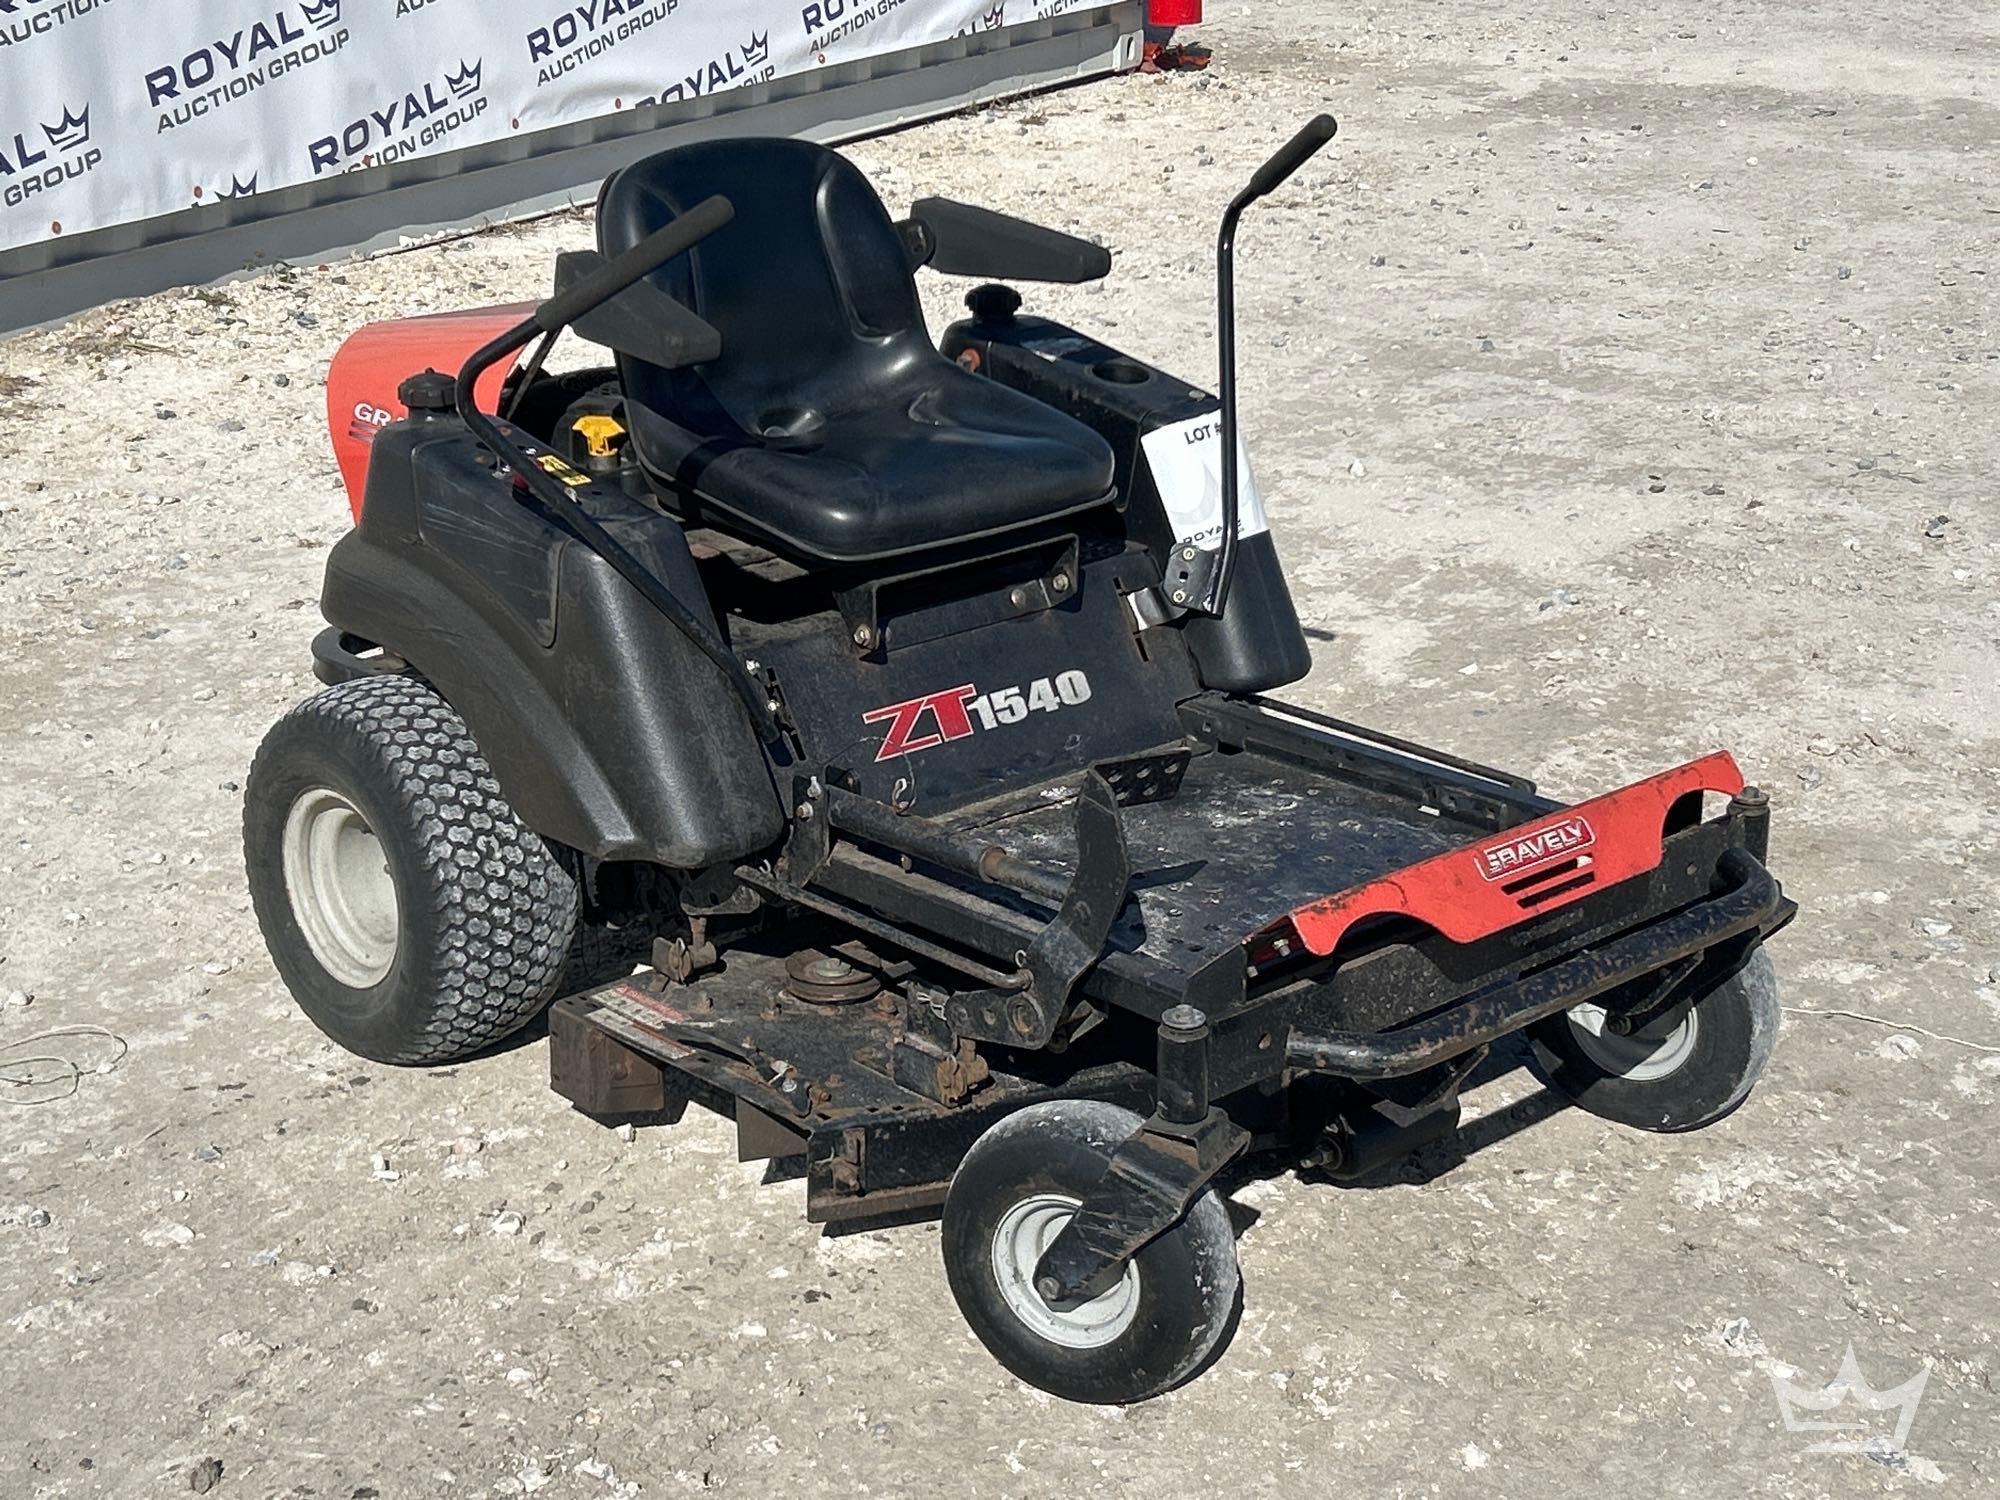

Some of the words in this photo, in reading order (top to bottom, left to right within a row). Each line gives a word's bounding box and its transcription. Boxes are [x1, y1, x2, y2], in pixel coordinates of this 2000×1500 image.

[145, 11, 304, 107] ROYAL
[537, 30, 615, 87] AUCTION
[617, 0, 678, 41] GROUP
[809, 7, 876, 55] AUCTION
[157, 68, 265, 134] AUCTION
[268, 28, 350, 79] GROUP
[308, 82, 448, 175] ROYAL
[420, 96, 488, 147] GROUP
[4, 148, 102, 207] GROUP
[1184, 424, 1211, 444] LOT
